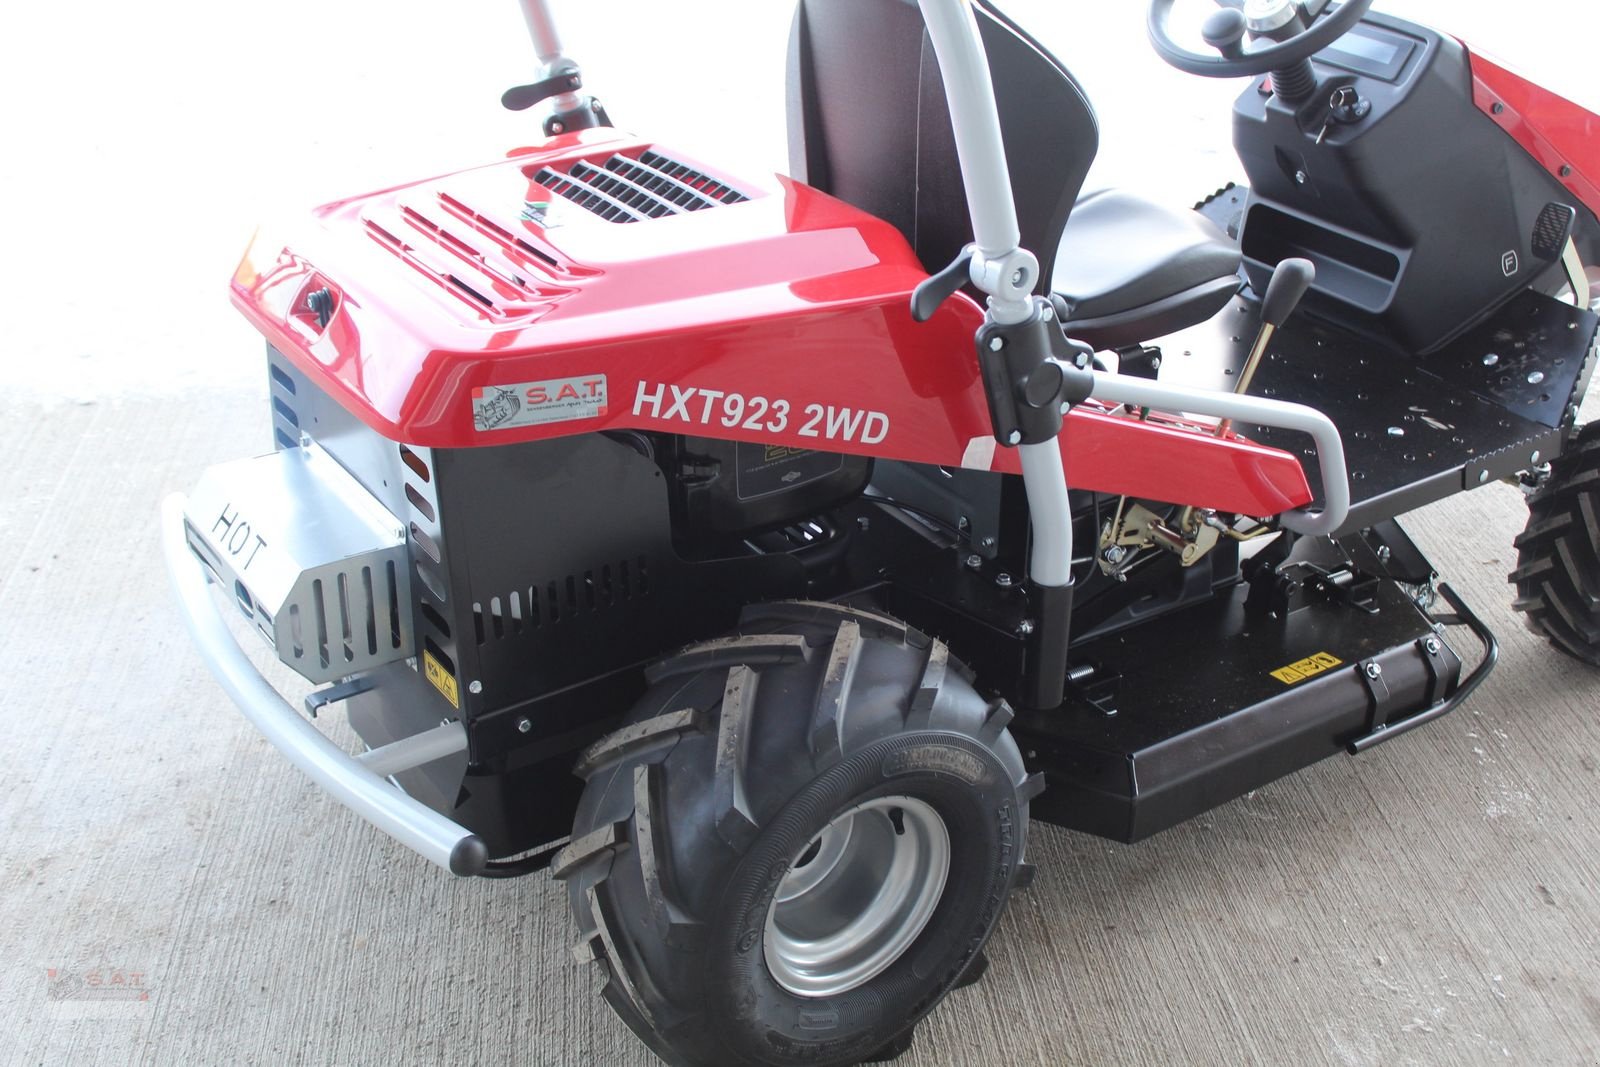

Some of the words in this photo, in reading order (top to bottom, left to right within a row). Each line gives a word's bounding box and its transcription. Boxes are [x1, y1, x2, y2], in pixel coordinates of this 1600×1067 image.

[526, 379, 603, 405] S.A.T.
[632, 380, 790, 433] HXT923
[798, 403, 890, 444] 2WD
[212, 502, 268, 570] HOT
